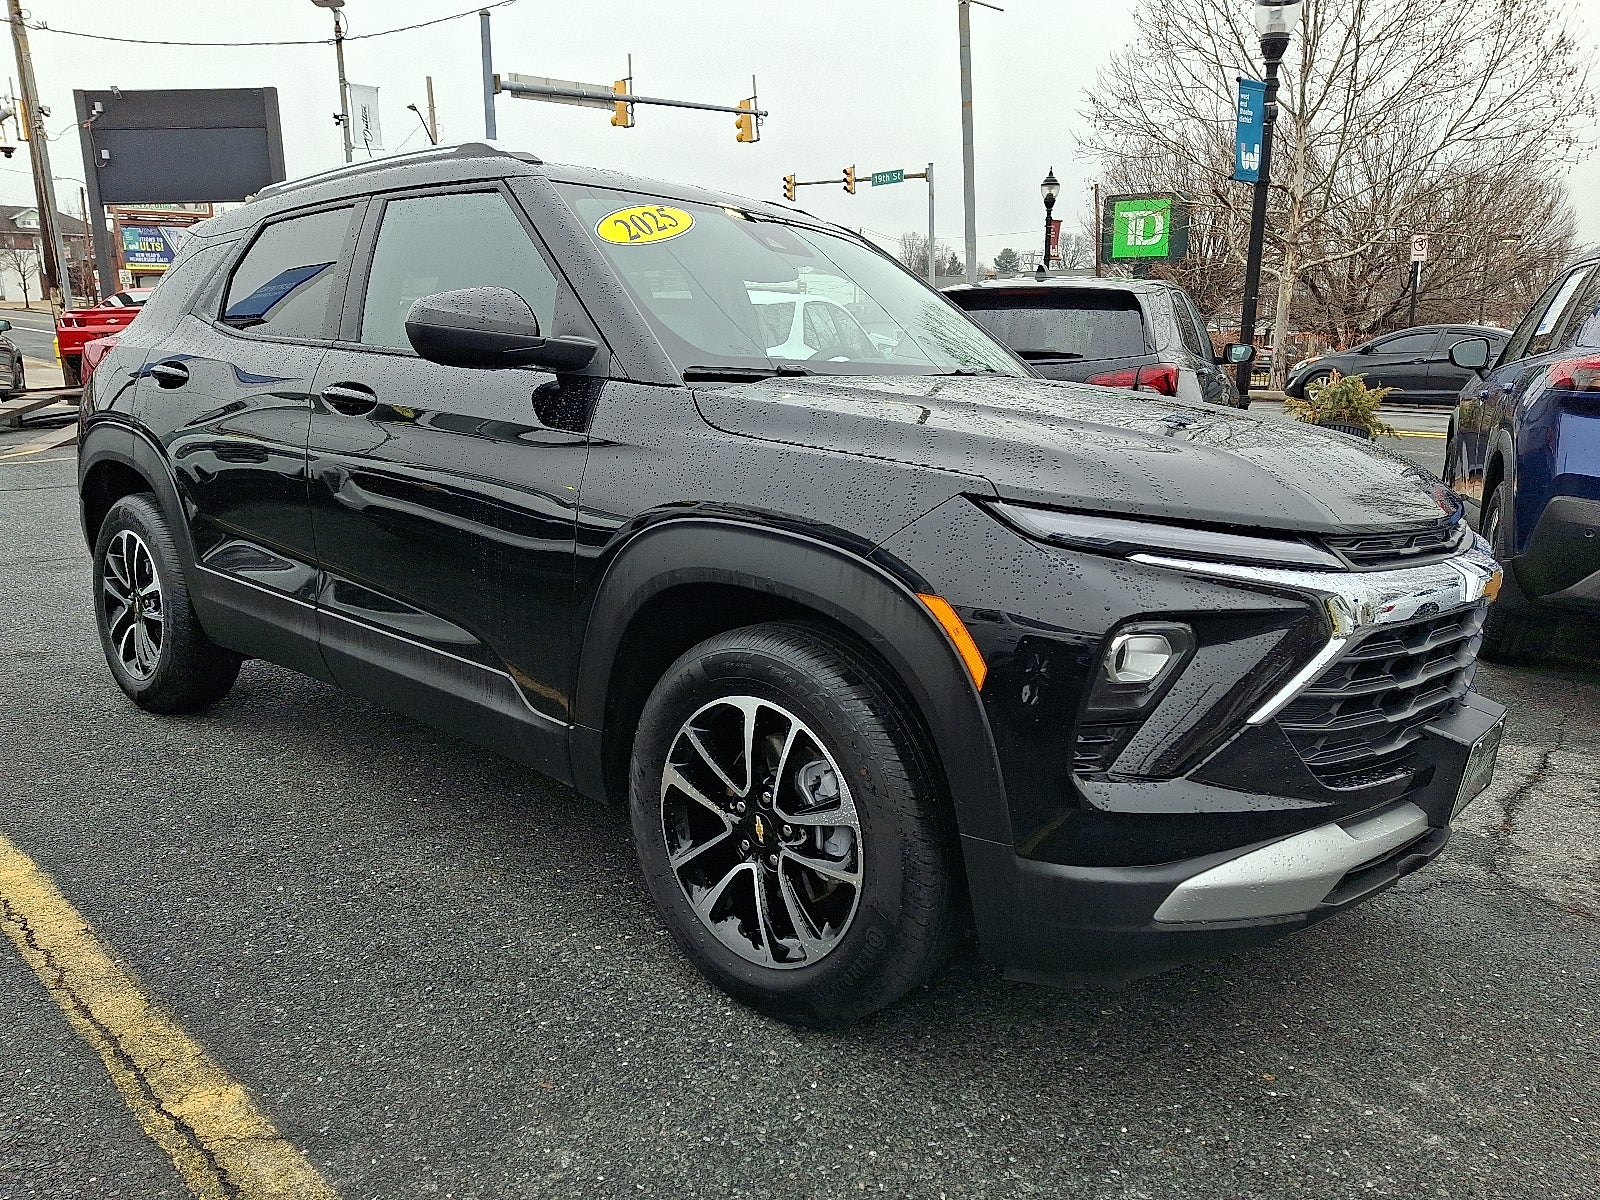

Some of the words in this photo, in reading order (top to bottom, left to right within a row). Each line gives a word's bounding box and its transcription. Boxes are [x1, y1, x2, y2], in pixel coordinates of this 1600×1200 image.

[875, 173, 890, 183] 19th
[892, 172, 901, 181] St
[614, 208, 678, 241] 2025
[1120, 210, 1164, 246] TD
